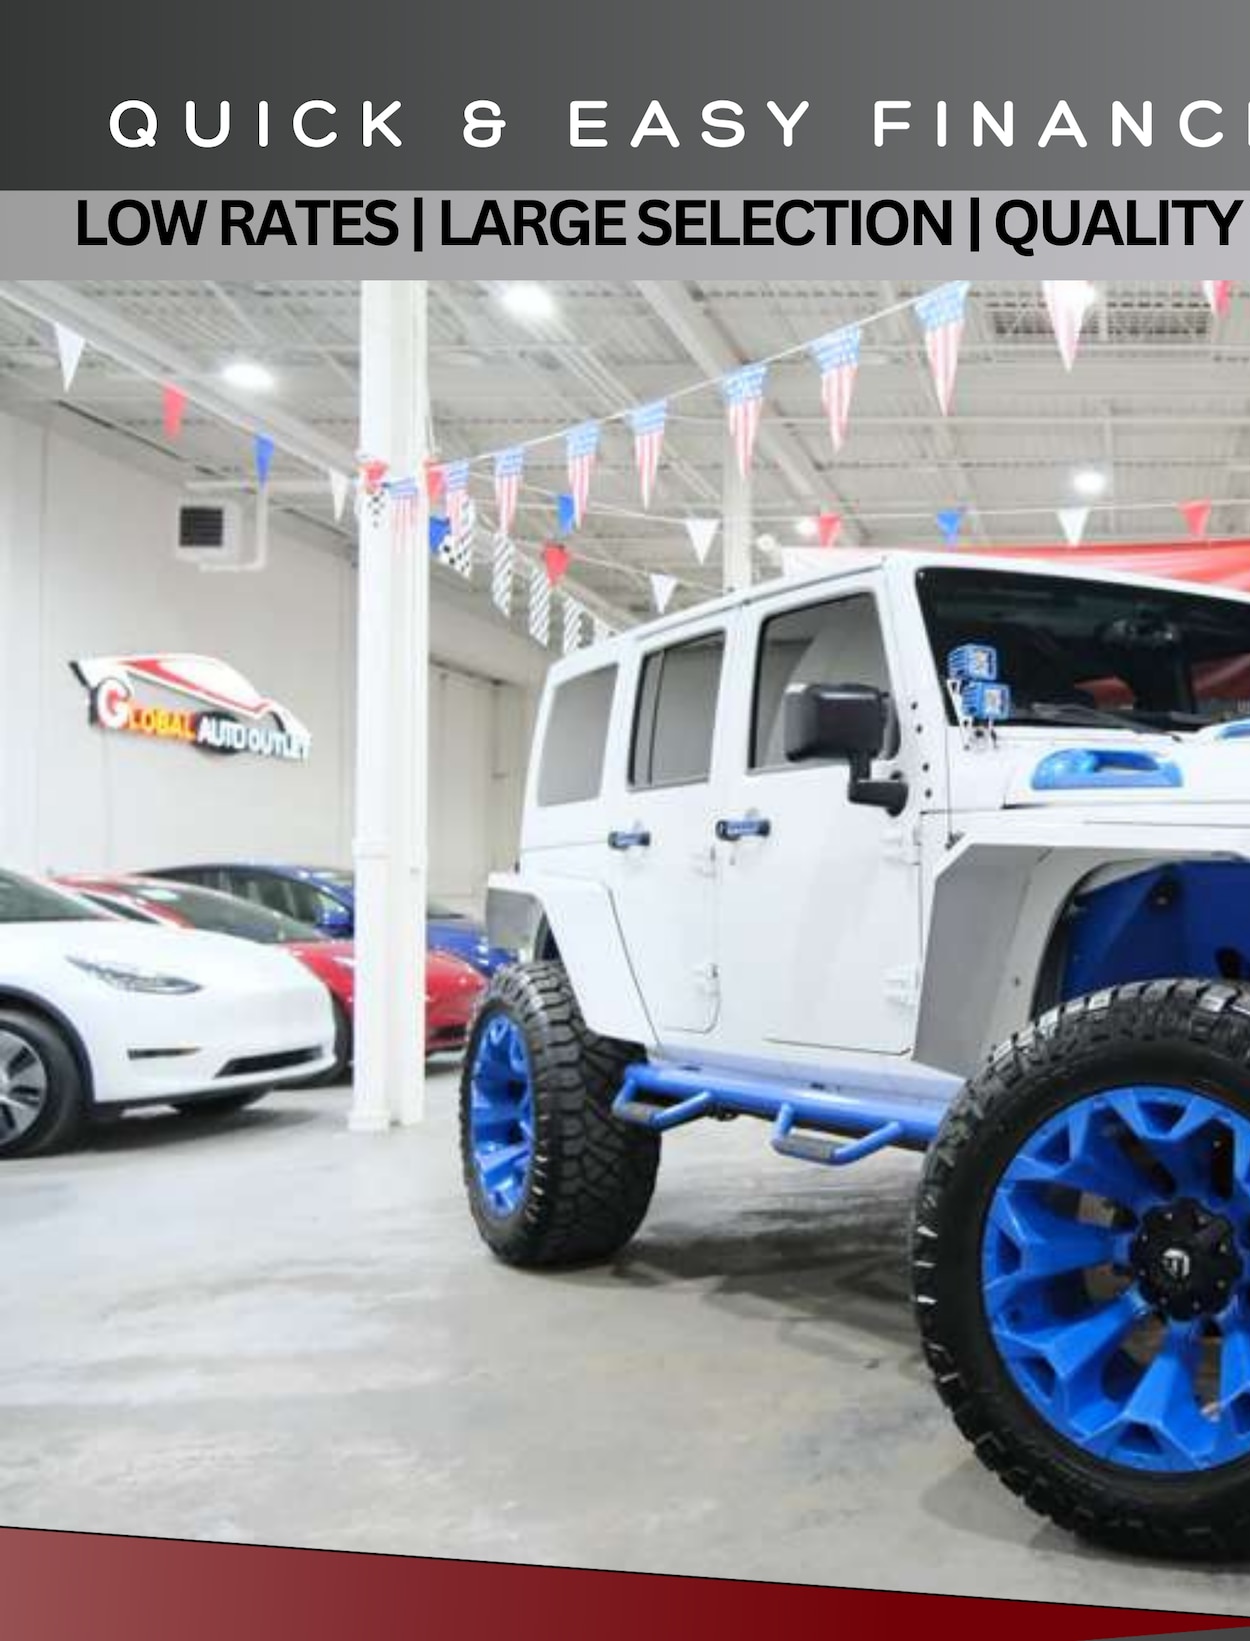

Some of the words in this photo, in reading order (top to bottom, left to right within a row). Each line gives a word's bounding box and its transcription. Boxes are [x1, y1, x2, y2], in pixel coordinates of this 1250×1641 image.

[97, 677, 197, 741] GLOBAL
[197, 715, 247, 750] AUTO
[248, 728, 312, 760] OUTLET
